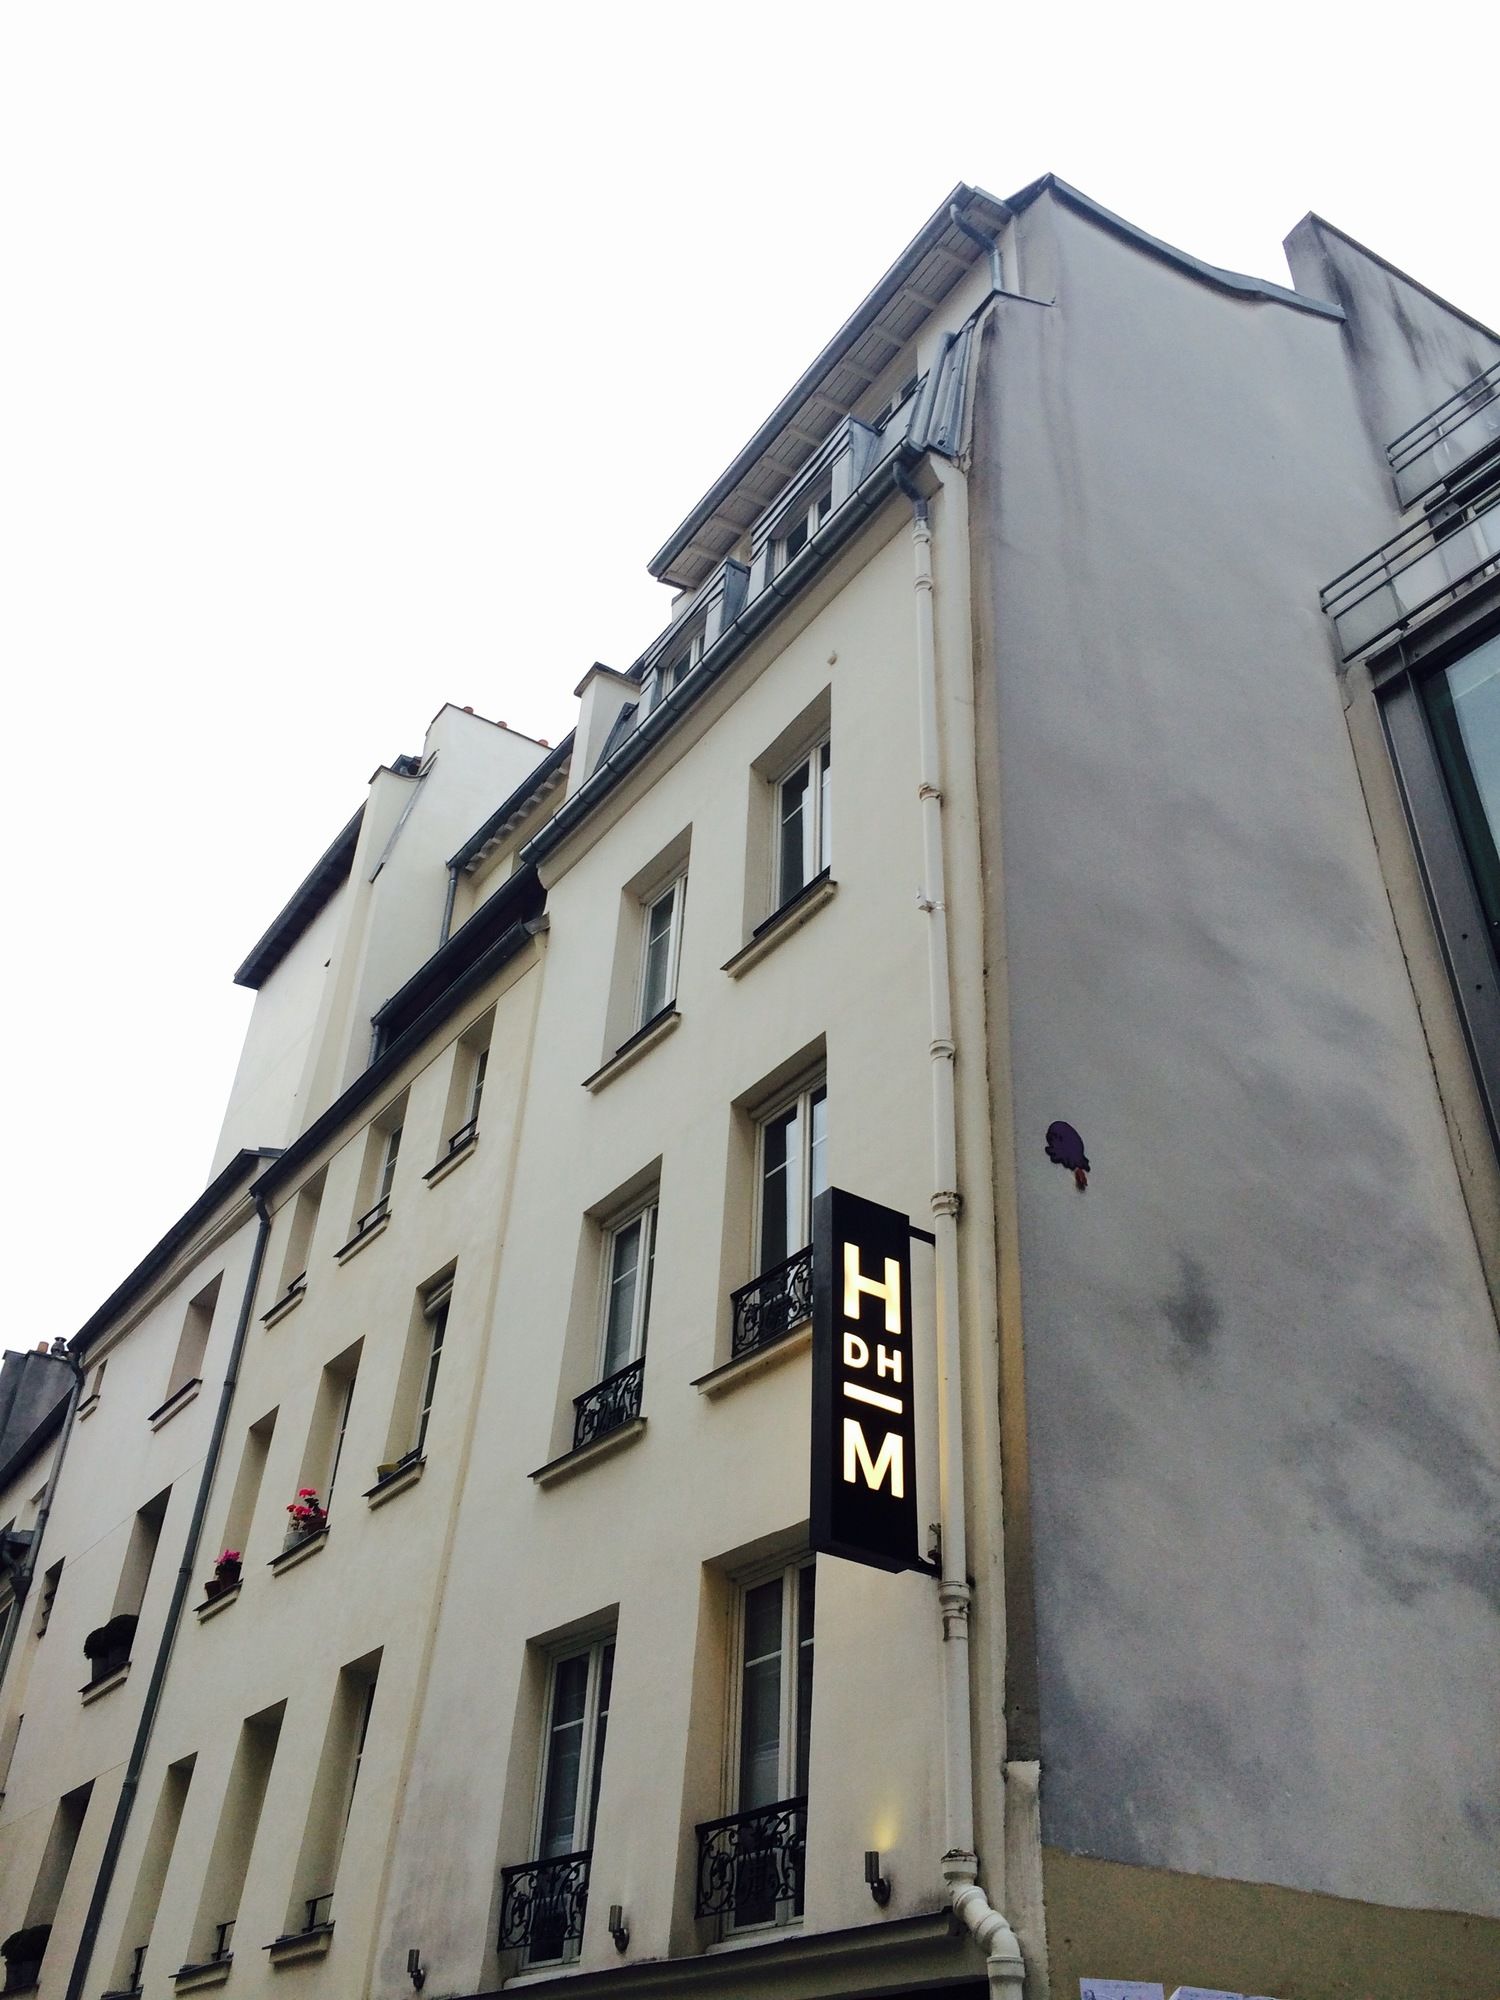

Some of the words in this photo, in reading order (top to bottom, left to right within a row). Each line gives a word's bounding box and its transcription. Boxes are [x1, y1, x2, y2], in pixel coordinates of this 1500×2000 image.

[843, 1241, 902, 1335] H
[843, 1331, 903, 1383] DH
[843, 1417, 904, 1499] M
